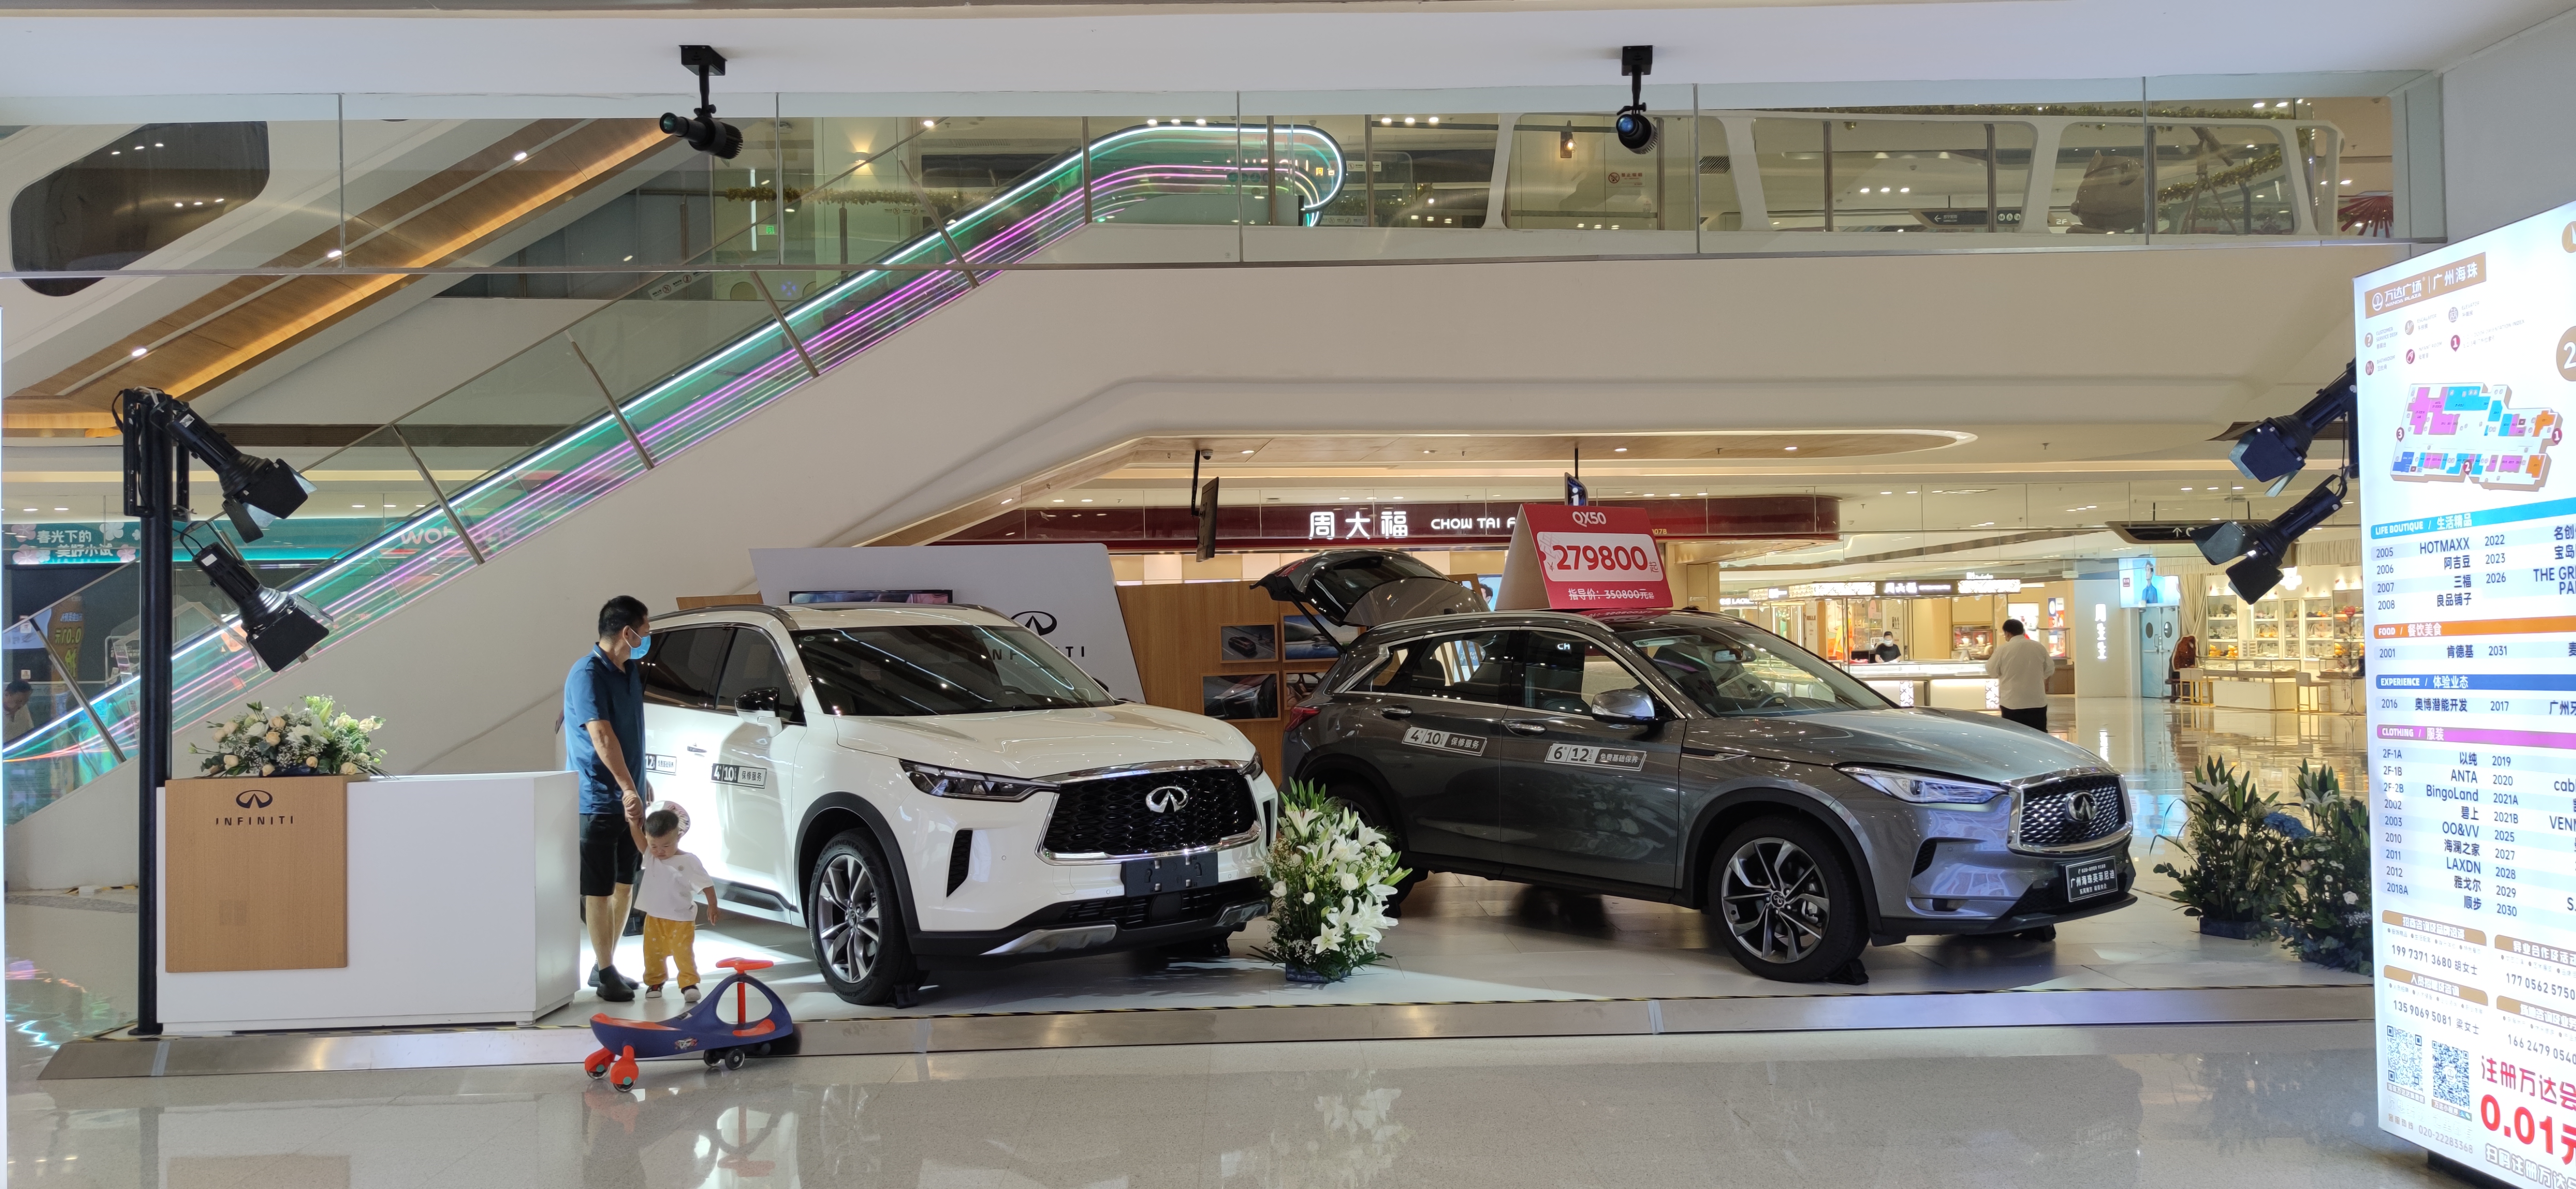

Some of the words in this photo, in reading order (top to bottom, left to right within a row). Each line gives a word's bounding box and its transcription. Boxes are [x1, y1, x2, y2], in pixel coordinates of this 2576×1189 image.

[2433, 261, 2477, 290] 广州海珠
[2384, 280, 2421, 302] 万达广场
[2404, 293, 2421, 301] PLAZA
[2376, 327, 2393, 335] CUSTOMER
[1310, 511, 1408, 539] 周大福
[1431, 518, 1472, 529] CHOW
[1477, 517, 1500, 529] TAI
[1572, 511, 1606, 528] QX50
[2376, 526, 2388, 535] LIFE
[2390, 521, 2423, 533] BOUTIQUE
[2437, 513, 2472, 530] 生活精品
[37, 530, 91, 544] 春光下的
[2554, 524, 2576, 540] 名创
[2420, 537, 2470, 554] HOTMAXX
[2485, 534, 2505, 546] 2022
[55, 543, 113, 557] 美好小试
[2376, 547, 2393, 558] 2005
[2554, 544, 2576, 560] 宝岛
[2444, 555, 2471, 570] 阿吉豆
[2485, 553, 2505, 564] 2023
[2376, 565, 2393, 574] 2006
[2533, 567, 2555, 582] THE
[2559, 566, 2576, 580] GR
[2454, 574, 2471, 588] 三福
[2486, 572, 2506, 583] 2026
[2377, 583, 2394, 593] 2007
[2559, 581, 2576, 595] PA
[2378, 600, 2395, 610] 2008
[2437, 593, 2472, 607] 良品铺子
[2378, 627, 2395, 635] FOOD
[2408, 623, 2442, 637] 餐饮美食
[2379, 648, 2395, 658] 2001
[2447, 645, 2473, 658] 肯德基
[2488, 645, 2507, 656] 2031
[2381, 678, 2420, 686] EXPERIENCE
[2433, 675, 2469, 689] 体验业态
[2382, 699, 2398, 708] 2016
[2415, 698, 2468, 712] 奥博潜能开发
[2490, 701, 2509, 711] 2017
[1410, 730, 1419, 742] 4
[1425, 732, 1441, 745] 10
[1451, 737, 1479, 749] 保修服务
[2382, 728, 2414, 737] CLOTHING
[2427, 727, 2444, 741] 服装
[1554, 746, 1563, 759] 6
[1571, 748, 1589, 762] 12
[1599, 753, 1638, 764] 免费基础保养
[2383, 749, 2402, 759] 2F-1A
[2459, 752, 2477, 766] 以纯
[2492, 756, 2511, 767] 2019
[714, 765, 720, 779] 4
[724, 767, 734, 781] 10
[741, 771, 762, 782] 保修服务
[2383, 766, 2402, 776] 2F-1B
[2451, 769, 2478, 783] ANTA
[2493, 774, 2513, 786] 2020
[2384, 783, 2404, 793] 2F-2B
[2426, 784, 2478, 802] BingoLand
[2384, 799, 2402, 810] 2002
[2493, 793, 2518, 805] 2021A
[216, 815, 293, 826] INFINITI
[2385, 816, 2402, 827] 2003
[2494, 811, 2518, 824] 2021B
[2442, 822, 2479, 838] OO&VV
[2495, 830, 2515, 842] 2025
[2386, 833, 2402, 844] 2010
[2444, 839, 2480, 856] 海澜之家
[2495, 848, 2515, 860] 2027
[2386, 850, 2401, 861] 2011
[2387, 866, 2403, 877] 2012
[2446, 857, 2481, 874] LAXDN
[2496, 867, 2516, 879] 2028
[2387, 882, 2409, 895] 2018A
[2454, 875, 2481, 892] 雅戈尔
[2496, 885, 2516, 898] 2029
[2497, 903, 2517, 917] 2030
[2392, 945, 2406, 956] 199
[2409, 949, 2427, 963] 7371
[2432, 955, 2451, 968] 3680
[2454, 960, 2477, 975] 胡女士
[2507, 973, 2522, 986] 177
[2525, 978, 2548, 994] 0562
[2552, 984, 2576, 1000] 5750
[2393, 1000, 2407, 1012] 135
[2410, 1006, 2429, 1019] 9069
[2432, 1011, 2451, 1026] 5081
[2456, 1018, 2479, 1035] 梁女士
[2508, 1034, 2524, 1048] 166
[2527, 1040, 2550, 1056] 2479
[2554, 1048, 2576, 1065] 0540
[2419, 1125, 2473, 1154] 020-22283368
